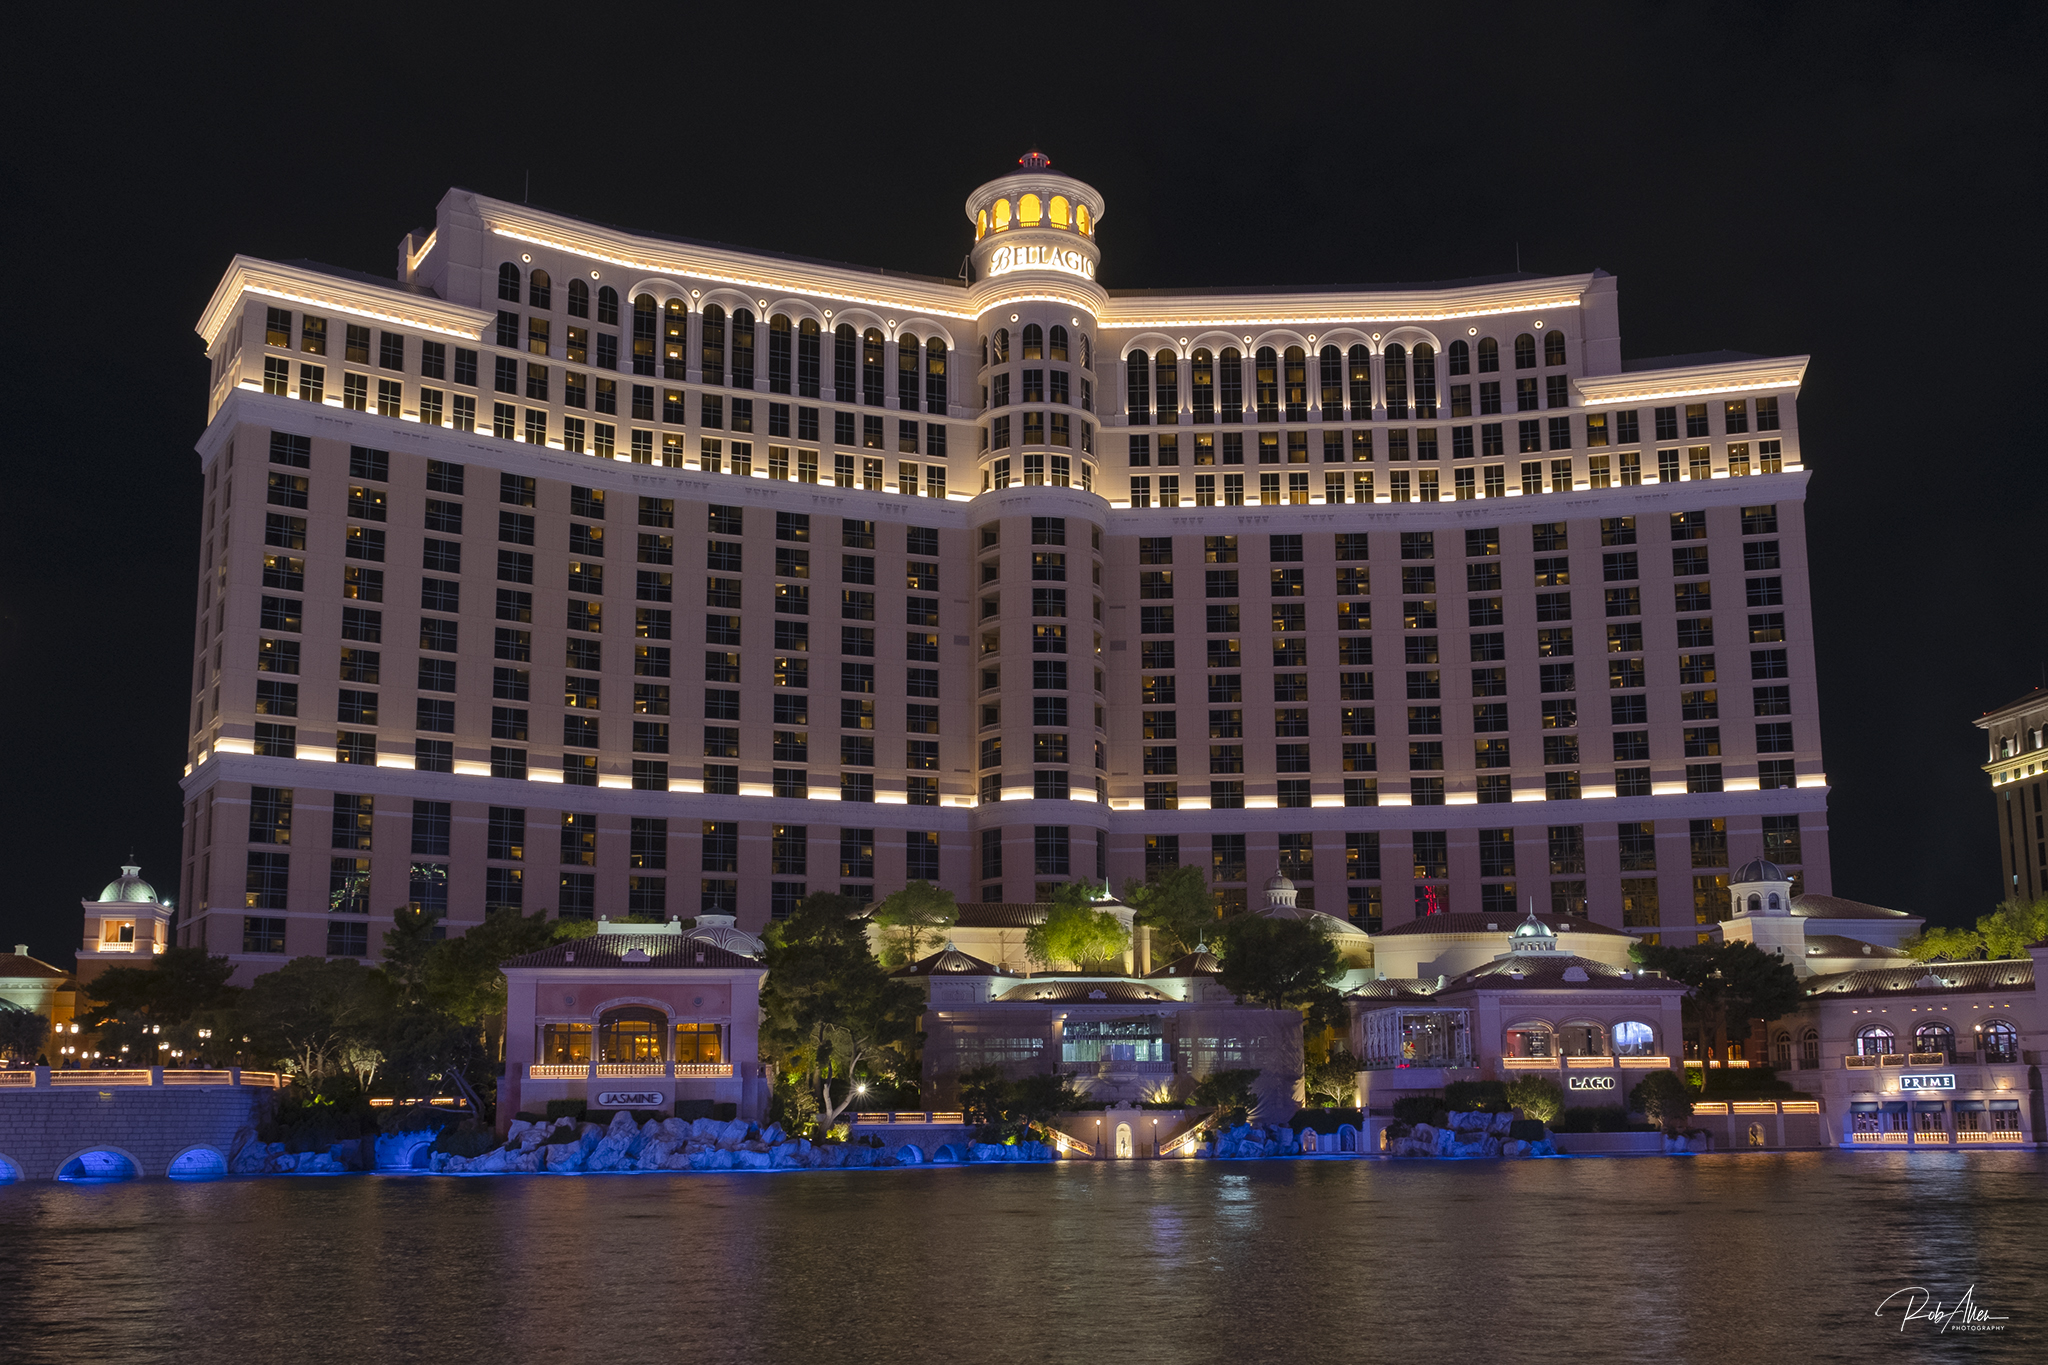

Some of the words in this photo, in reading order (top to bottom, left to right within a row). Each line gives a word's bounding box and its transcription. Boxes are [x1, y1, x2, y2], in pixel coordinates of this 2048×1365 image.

[988, 245, 1095, 278] BELLAGIO
[1569, 1076, 1616, 1090] LAGO
[1904, 1077, 1950, 1088] PRIME
[604, 1093, 659, 1104] JASMINE
